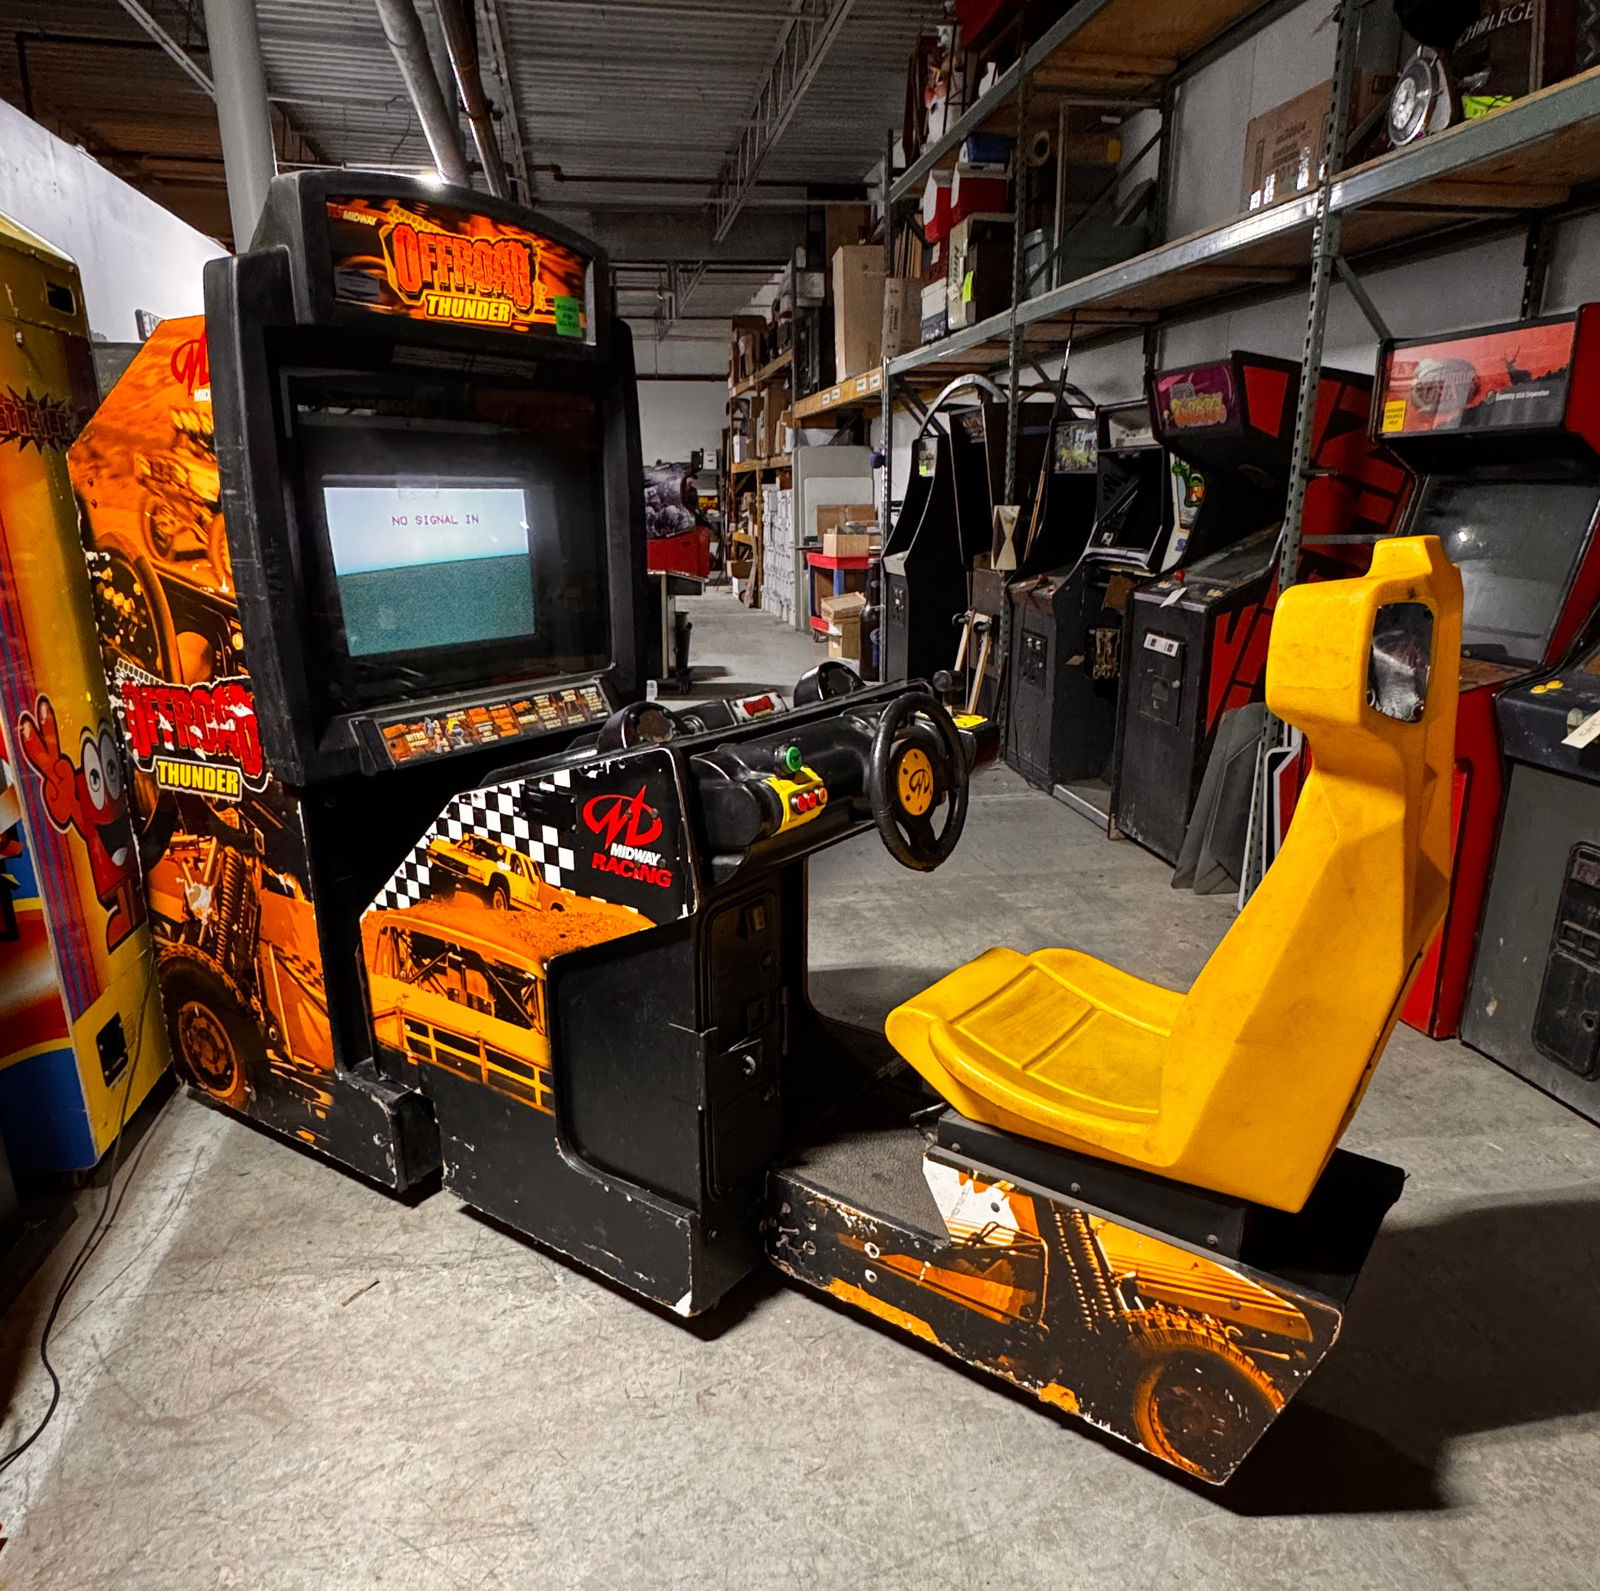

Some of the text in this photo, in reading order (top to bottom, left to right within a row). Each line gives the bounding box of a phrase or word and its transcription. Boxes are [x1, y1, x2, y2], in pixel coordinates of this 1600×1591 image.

[342, 210, 378, 226] MIDWAY
[392, 224, 533, 309] OFFROAD
[425, 295, 511, 322] THUNDER
[391, 514, 480, 526] NO SIGNAL IN
[122, 680, 263, 778] OFFROAD
[157, 760, 239, 795] THUNDER
[591, 852, 673, 888] RACING
[610, 842, 662, 867] MIDWAY
